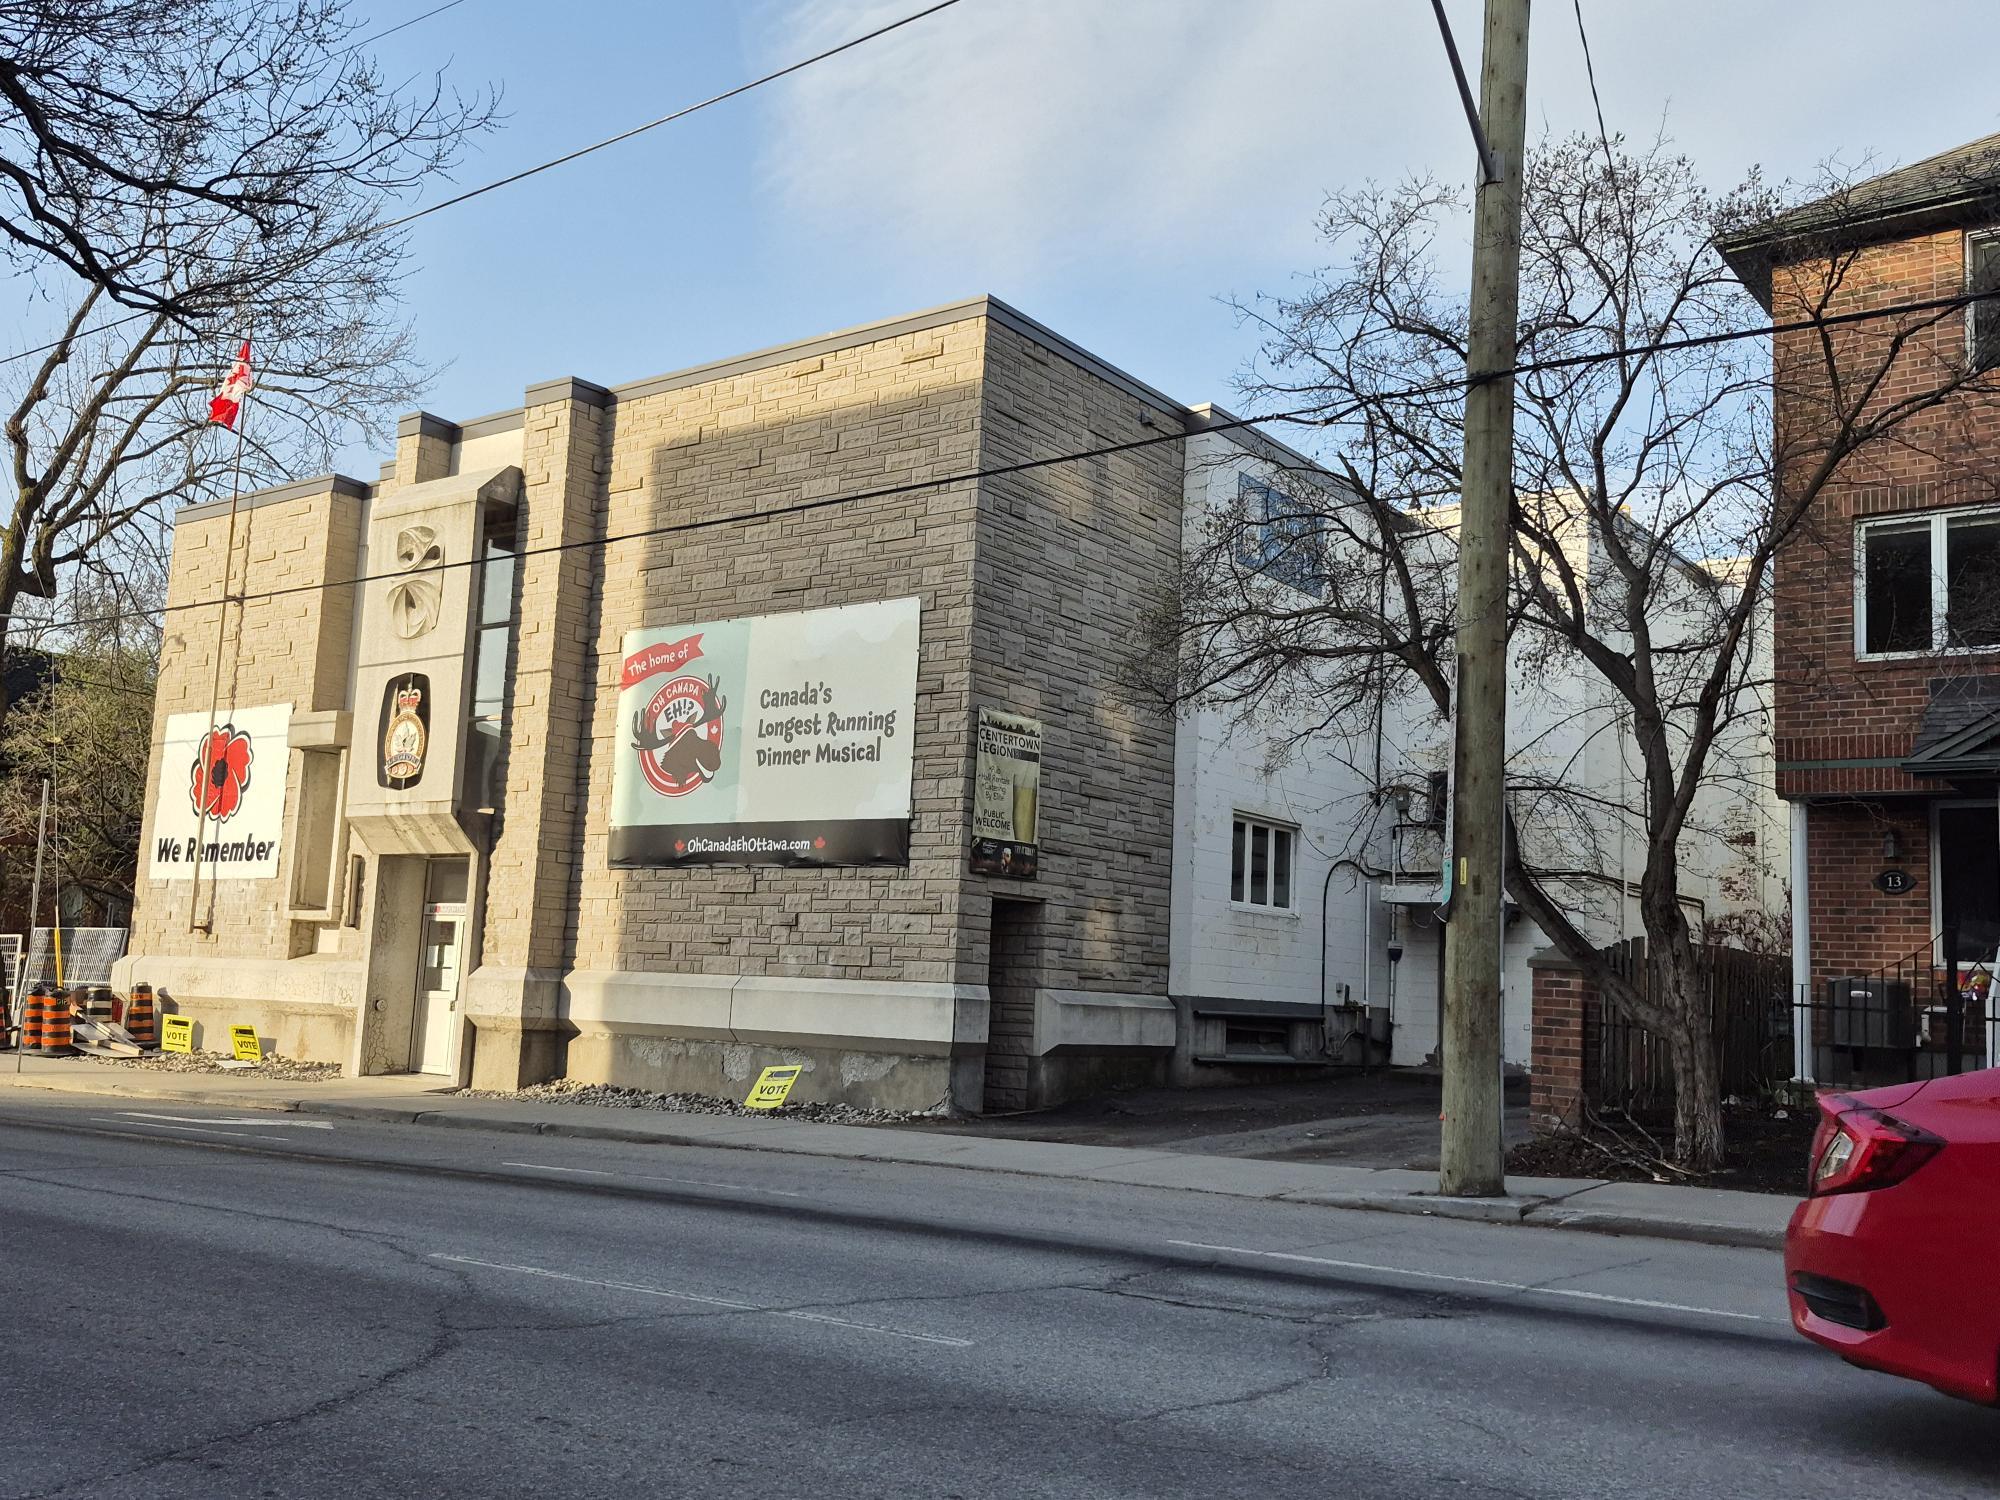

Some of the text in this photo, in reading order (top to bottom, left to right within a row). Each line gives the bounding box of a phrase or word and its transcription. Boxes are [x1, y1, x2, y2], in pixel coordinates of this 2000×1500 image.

[628, 643, 689, 677] The home of
[652, 682, 699, 713] OH CANADA
[760, 681, 833, 709] Canada's
[664, 699, 695, 722] EH!?
[757, 709, 897, 744] Longest Running
[979, 727, 1040, 751] CENTERTOWN
[756, 736, 881, 767] Dinner Musical
[978, 742, 1014, 759] LEGION
[975, 816, 1011, 831] WELCOME
[983, 808, 1006, 819] PUBLIC
[157, 837, 182, 863] We
[687, 835, 810, 853] OhCanadaEhOttawa.com
[1887, 876, 1902, 888] 13
[166, 1031, 188, 1042] VOTE
[237, 1040, 258, 1050] VOTE
[759, 1084, 789, 1095] VOTE
